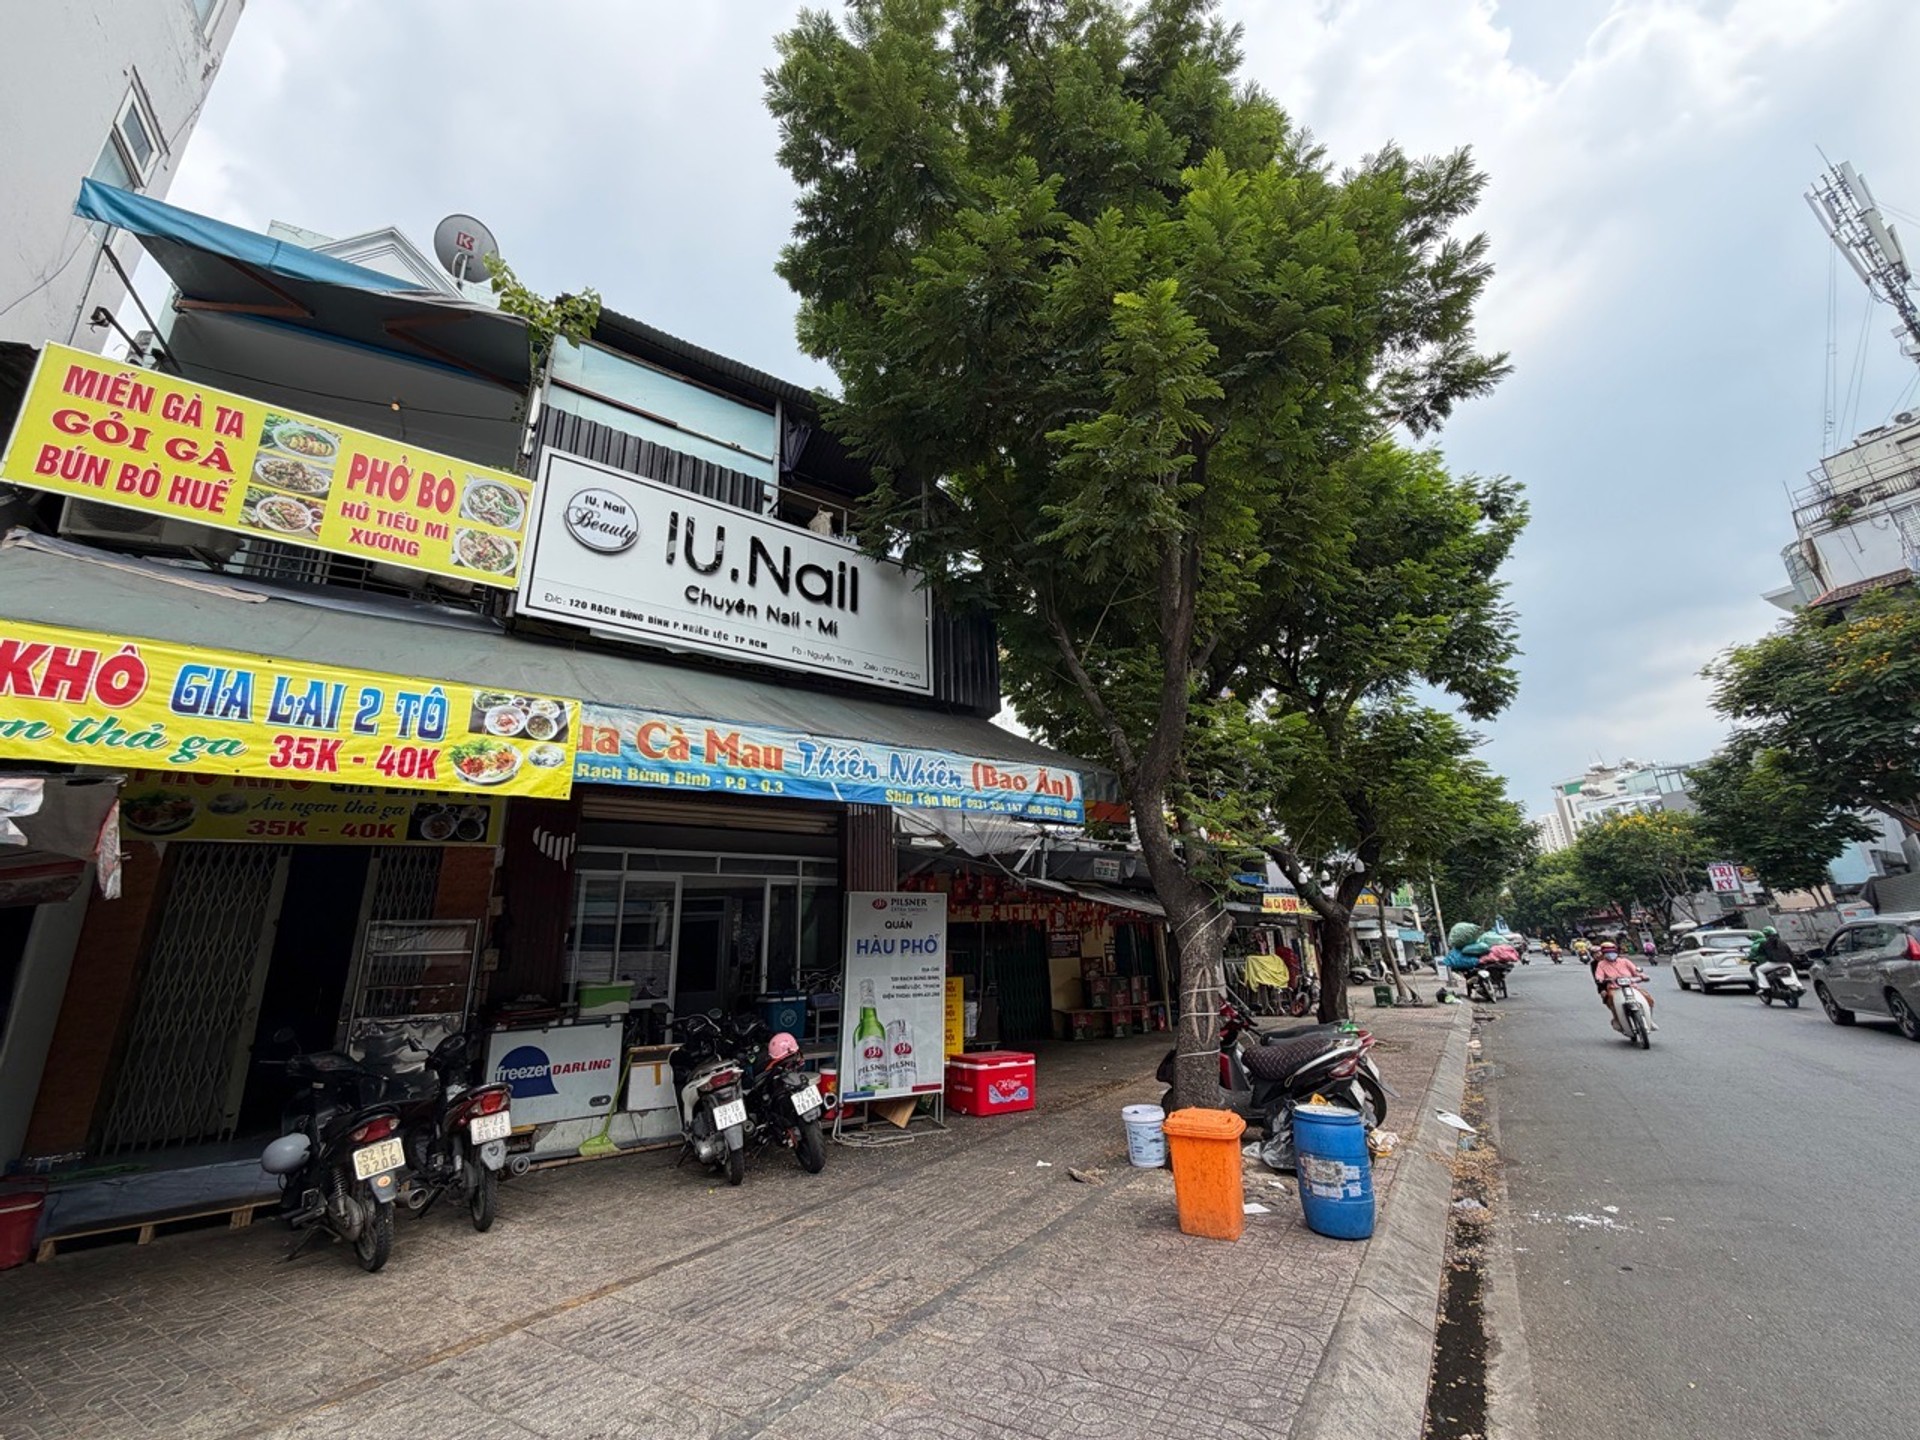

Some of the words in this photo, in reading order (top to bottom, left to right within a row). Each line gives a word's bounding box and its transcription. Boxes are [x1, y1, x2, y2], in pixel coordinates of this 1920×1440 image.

[160, 391, 204, 428] GÀ
[214, 404, 246, 439] TA
[52, 408, 154, 452] GỎI
[164, 437, 235, 473] GÀ
[34, 443, 111, 487] BÚN
[115, 462, 161, 498] BÒ
[168, 474, 236, 513] HUẾ
[346, 452, 415, 503] PHỞ
[416, 469, 456, 513] BÒ
[340, 501, 370, 521] HỦ
[424, 521, 450, 541] MÌ
[569, 506, 638, 547] Beauty
[603, 500, 627, 515] Nail
[349, 527, 420, 557] XƯƠNG
[569, 598, 588, 610] 120
[590, 602, 617, 616] RẠCH
[735, 635, 745, 645] TP
[749, 639, 768, 650] HCM
[684, 584, 758, 620] Chuyên
[767, 603, 801, 630] Nail
[0, 640, 149, 709] KHÔ
[170, 664, 254, 721] GIA
[267, 676, 347, 730] LAI
[354, 688, 388, 735] 2
[397, 684, 449, 742] TÔ
[65, 715, 168, 749] thả
[168, 731, 250, 763] ga
[269, 734, 346, 773] 35K
[375, 744, 441, 781] 40K
[635, 721, 691, 762] Cà
[703, 728, 784, 771] Mau
[797, 740, 879, 780] Thiên
[889, 752, 964, 790] Nhiên
[971, 762, 1028, 793] (Bao
[1035, 767, 1074, 803] Ăn)
[577, 763, 622, 782] Rạch
[289, 801, 337, 817] ngon
[343, 797, 377, 816] thả
[378, 805, 406, 820] ga
[885, 789, 913, 805] Ship
[917, 794, 940, 808] Tận
[246, 819, 307, 837] 35K
[339, 822, 396, 839] 40K
[890, 897, 928, 907] PILSNER
[856, 933, 895, 955] HÀU
[900, 932, 941, 954] PHỐ
[495, 1064, 549, 1082] freezer
[551, 1059, 612, 1076] DARLING
